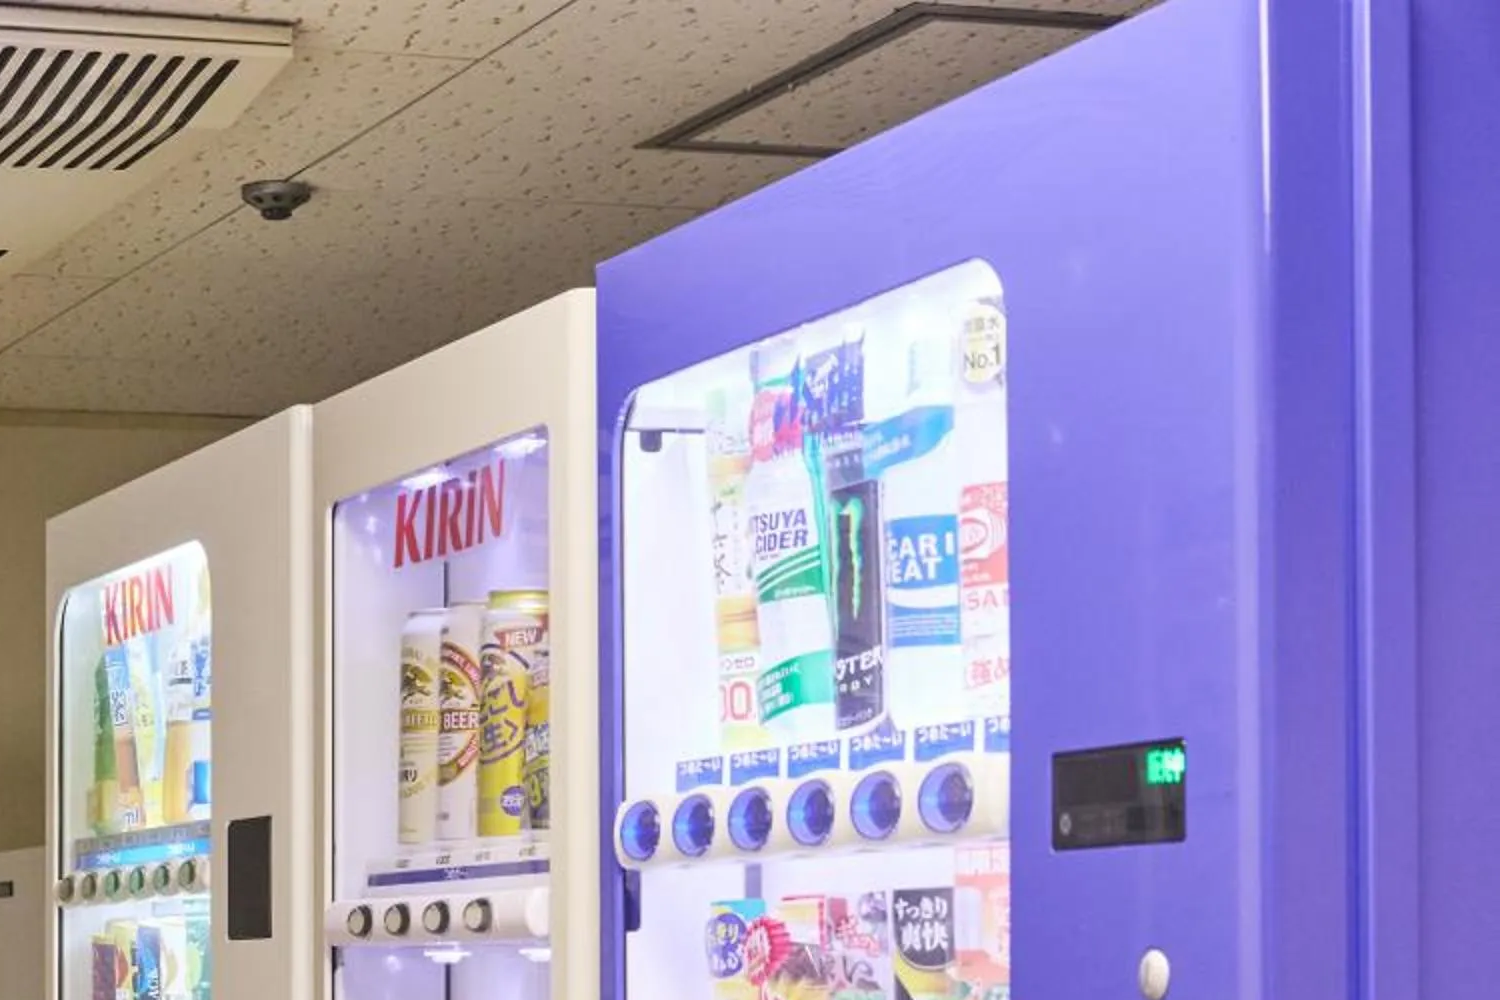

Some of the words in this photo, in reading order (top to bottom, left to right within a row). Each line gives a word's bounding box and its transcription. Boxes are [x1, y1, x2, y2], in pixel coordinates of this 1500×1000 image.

[393, 456, 505, 569] KIRIN
[755, 529, 809, 554] CIDER
[105, 563, 175, 646] KIRIN
[443, 711, 479, 729] BEER
[894, 896, 949, 920] すっきり
